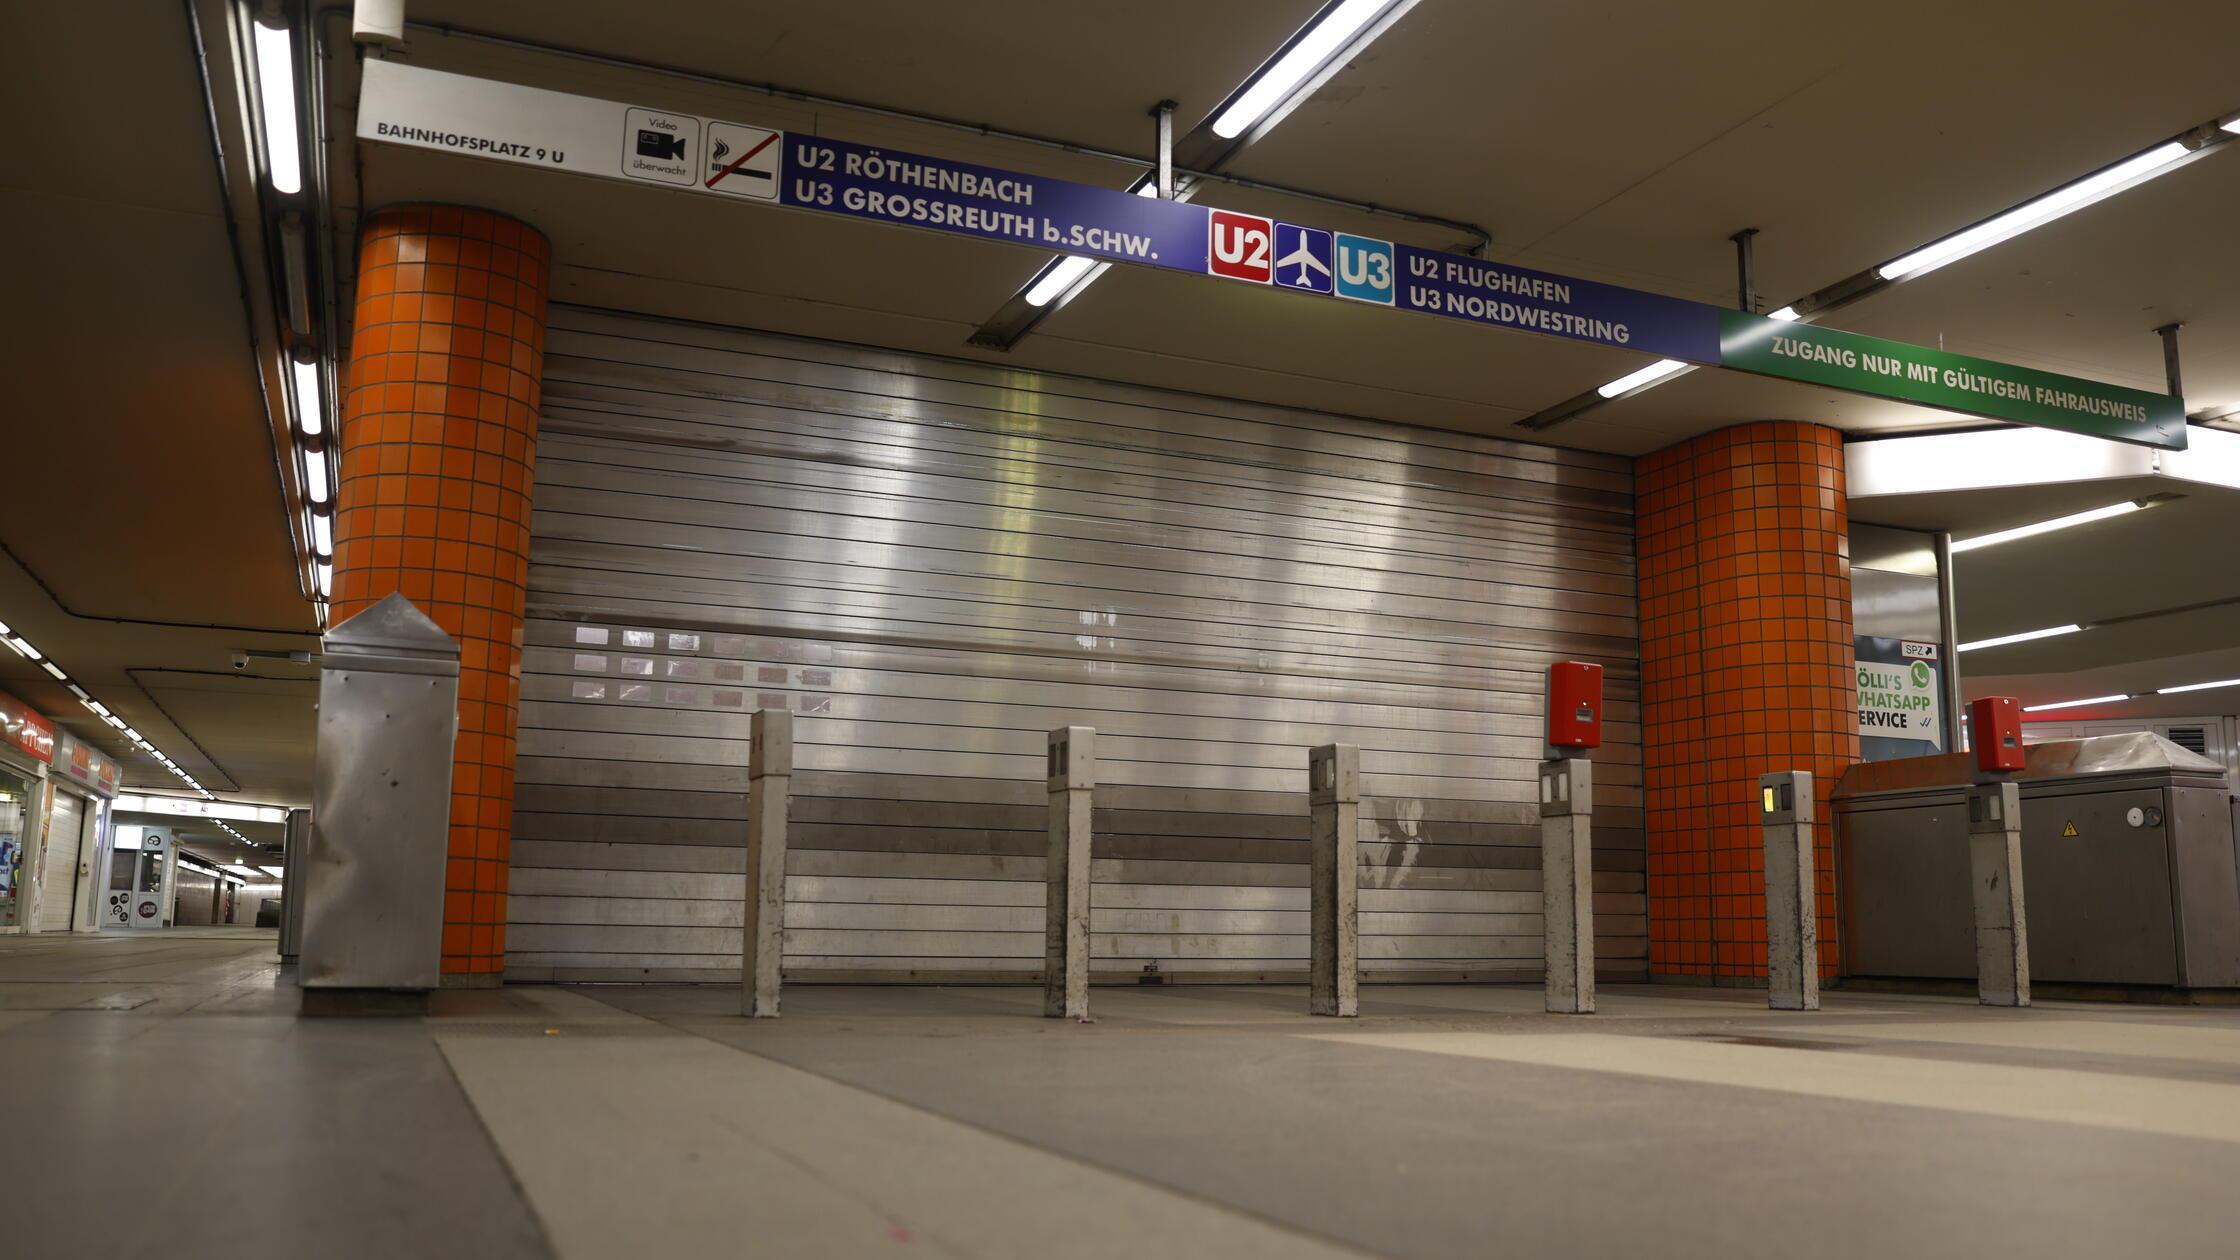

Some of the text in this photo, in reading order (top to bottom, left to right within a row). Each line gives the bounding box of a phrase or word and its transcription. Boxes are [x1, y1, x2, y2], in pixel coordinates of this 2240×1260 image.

[377, 122, 565, 164] BAHNHOFSPLATZ 9 U
[649, 118, 677, 131] Video
[633, 159, 686, 176] überwacht
[797, 144, 1033, 206] U2 RÖTHENBACH
[795, 179, 1159, 260] U3 GROSSREUTH b.SCHW.
[1214, 223, 1269, 270] U2
[1340, 246, 1391, 289] U3
[1409, 255, 1571, 305] U2 FLUGHAFEN
[1410, 286, 1630, 344] U3 NORDWESTRING
[1771, 336, 2148, 423] ZUGANG NUR MIT GÜLTIGEM FAHRAUSWEIS
[1906, 644, 1924, 656] SPZ
[1857, 667, 1902, 690] ÖLLI'S
[1858, 710, 1907, 728] ERVICE
